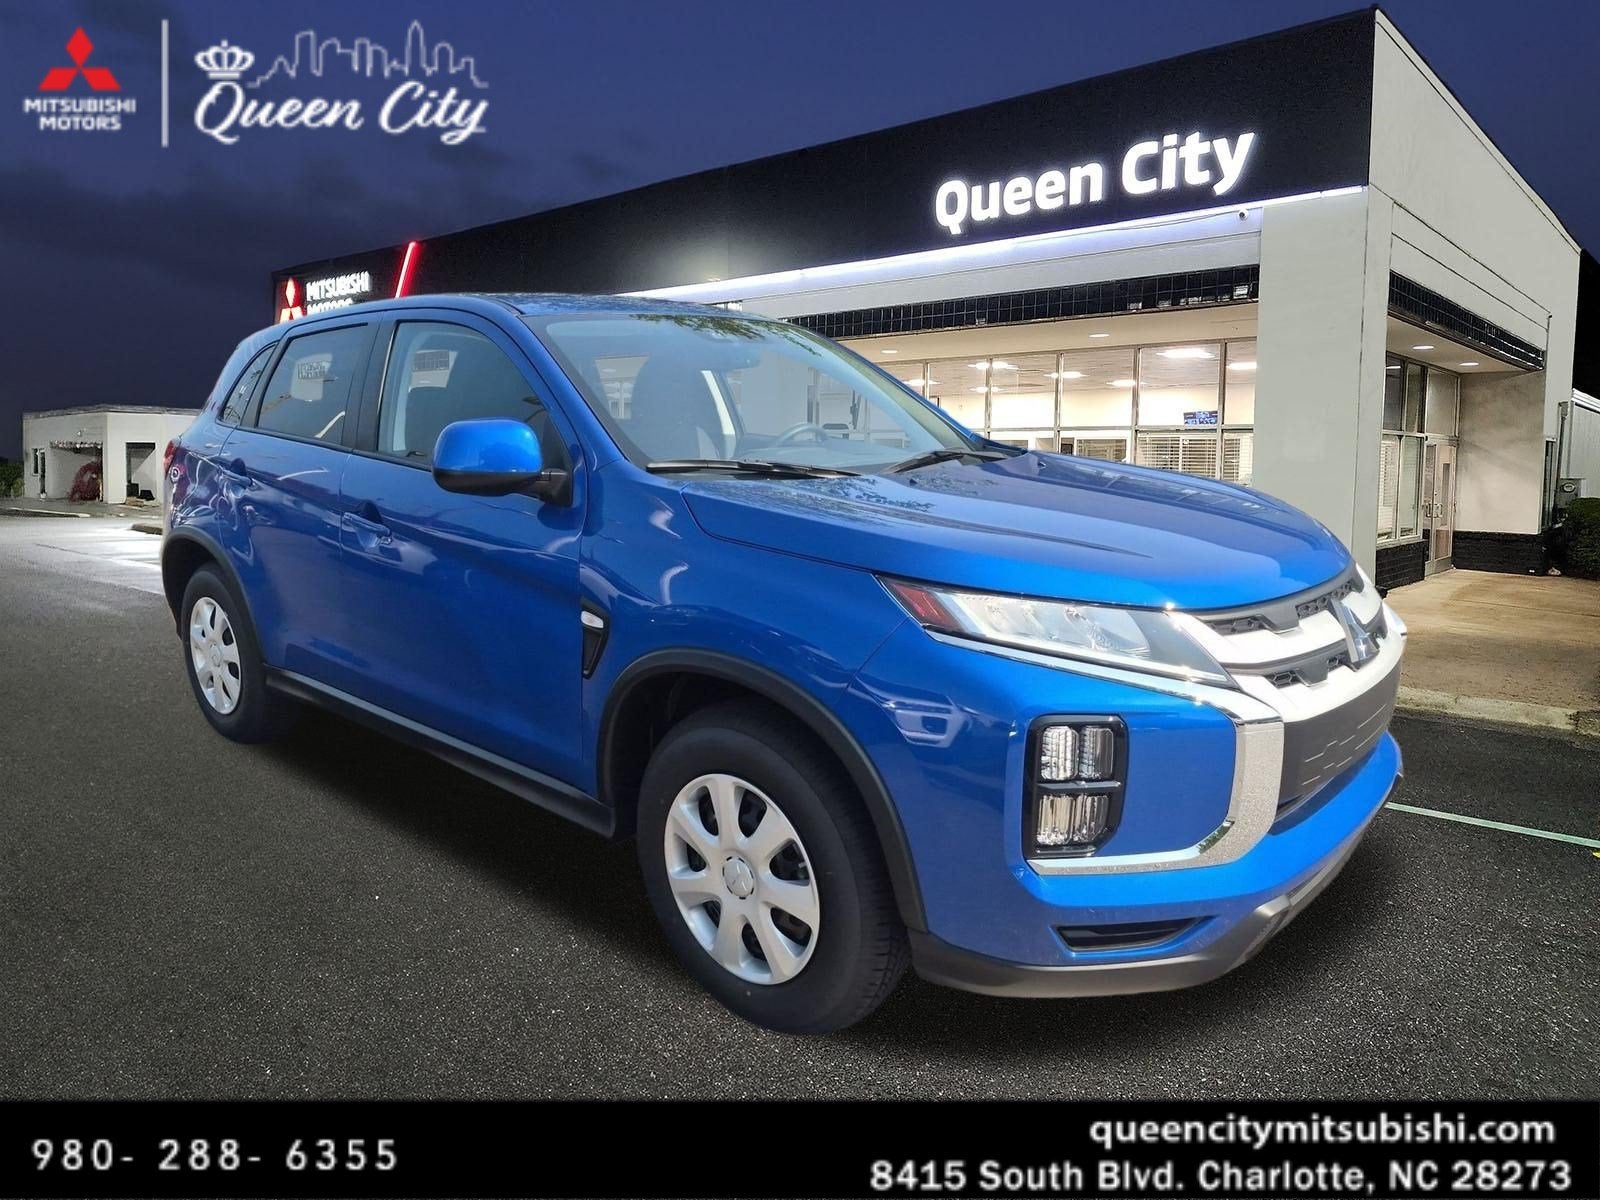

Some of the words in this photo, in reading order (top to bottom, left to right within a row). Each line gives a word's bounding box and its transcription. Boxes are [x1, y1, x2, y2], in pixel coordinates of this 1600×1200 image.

[935, 162, 1104, 235] Queen
[1121, 131, 1256, 196] City
[306, 270, 371, 301] MITSUBISHI
